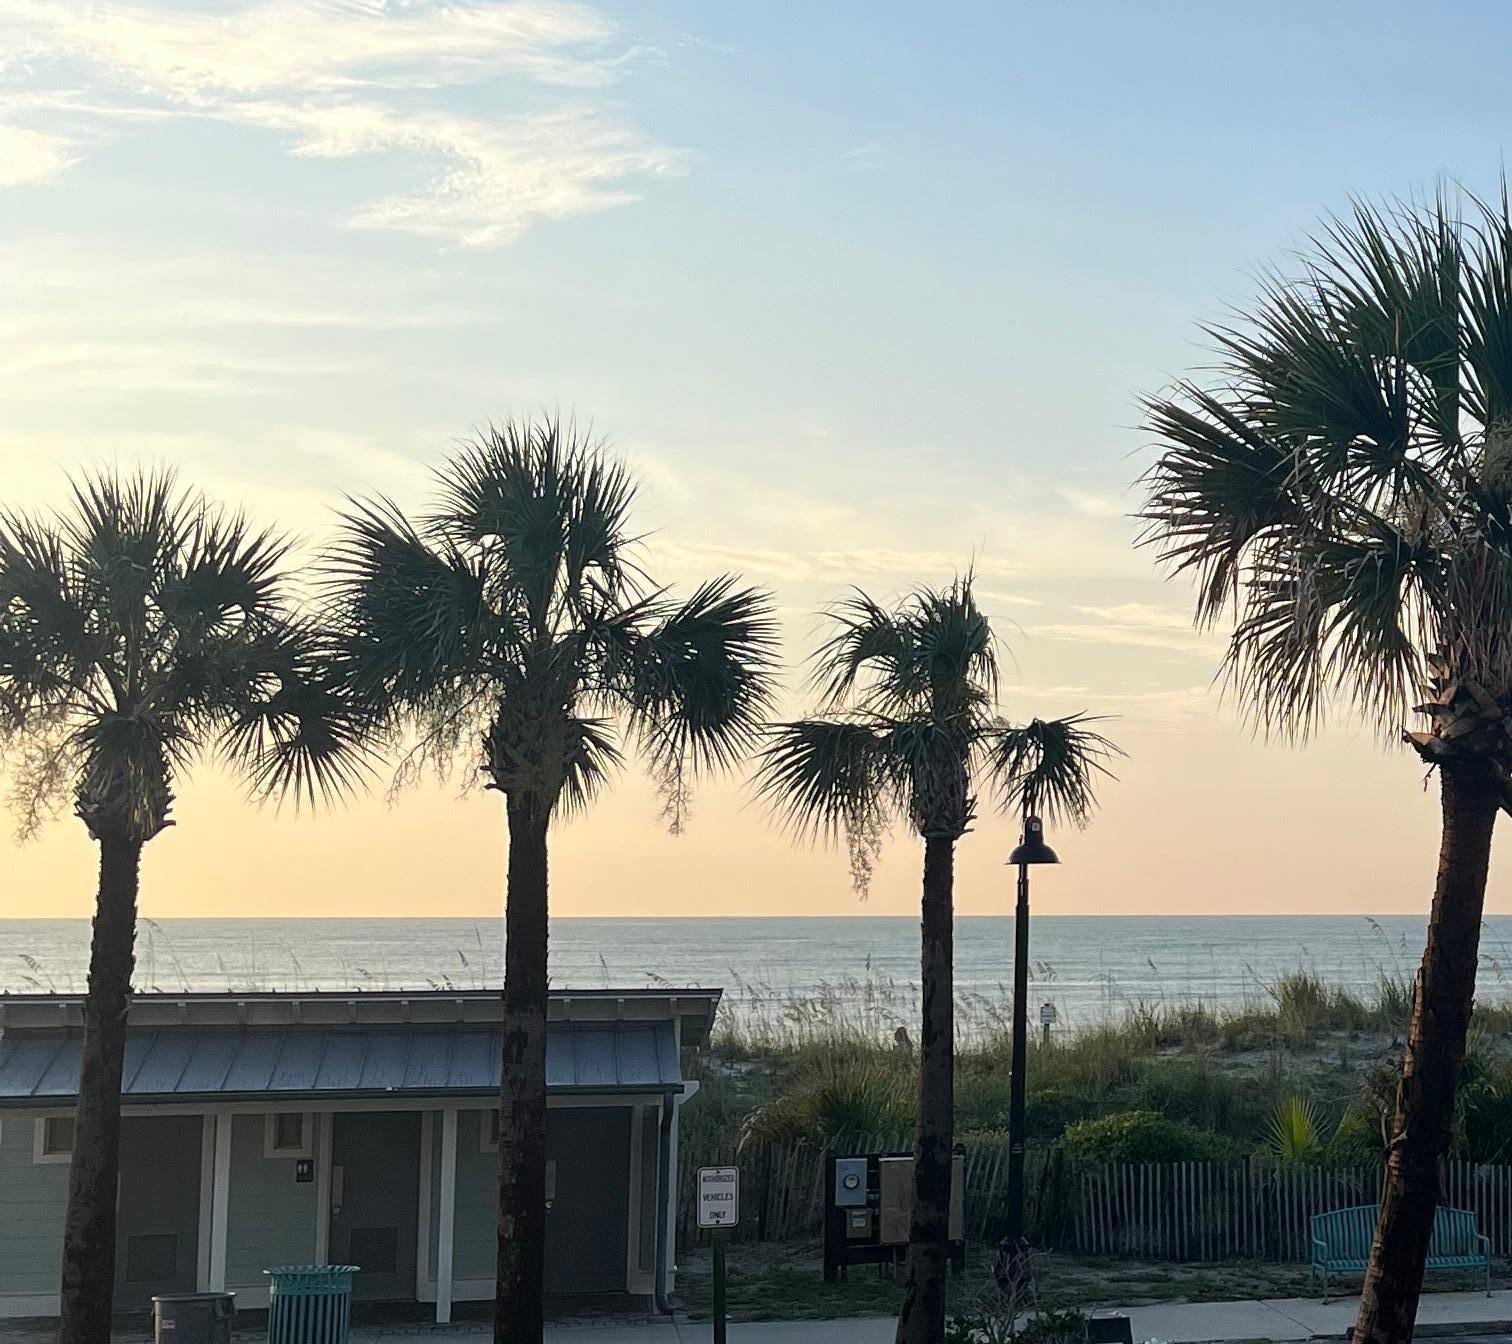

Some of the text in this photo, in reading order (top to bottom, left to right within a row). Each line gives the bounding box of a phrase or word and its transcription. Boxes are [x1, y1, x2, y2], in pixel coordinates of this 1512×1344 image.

[703, 1174, 736, 1183] AUTHORIZED
[703, 1192, 734, 1201] VEHICLES
[709, 1210, 727, 1219] ONLY
